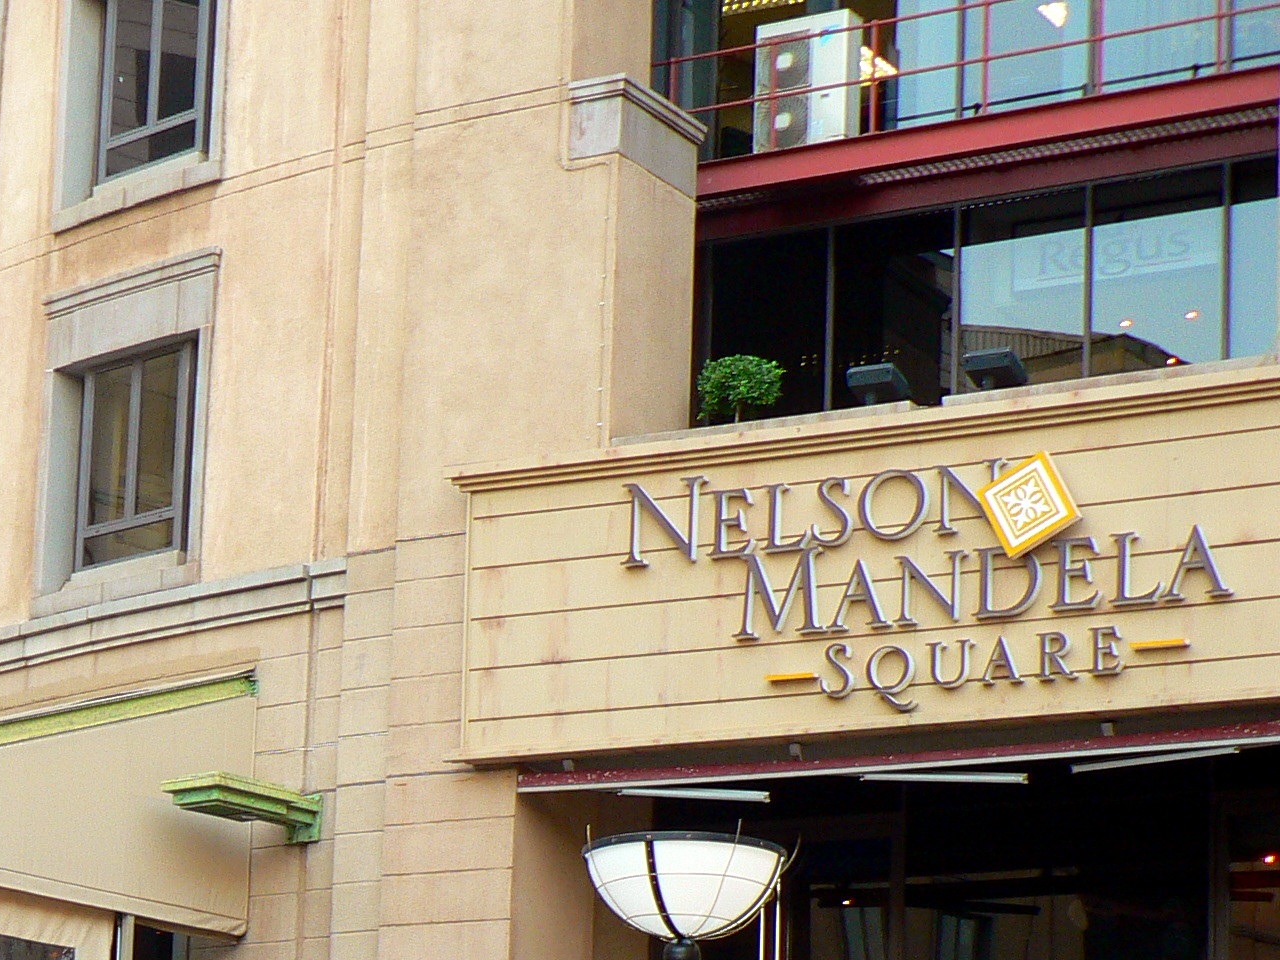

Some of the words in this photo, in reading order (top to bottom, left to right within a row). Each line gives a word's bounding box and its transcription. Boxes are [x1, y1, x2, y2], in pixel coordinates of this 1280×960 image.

[622, 457, 1009, 569] NELSON
[732, 523, 1236, 641] MANDELA
[818, 625, 1125, 713] SQUARE
